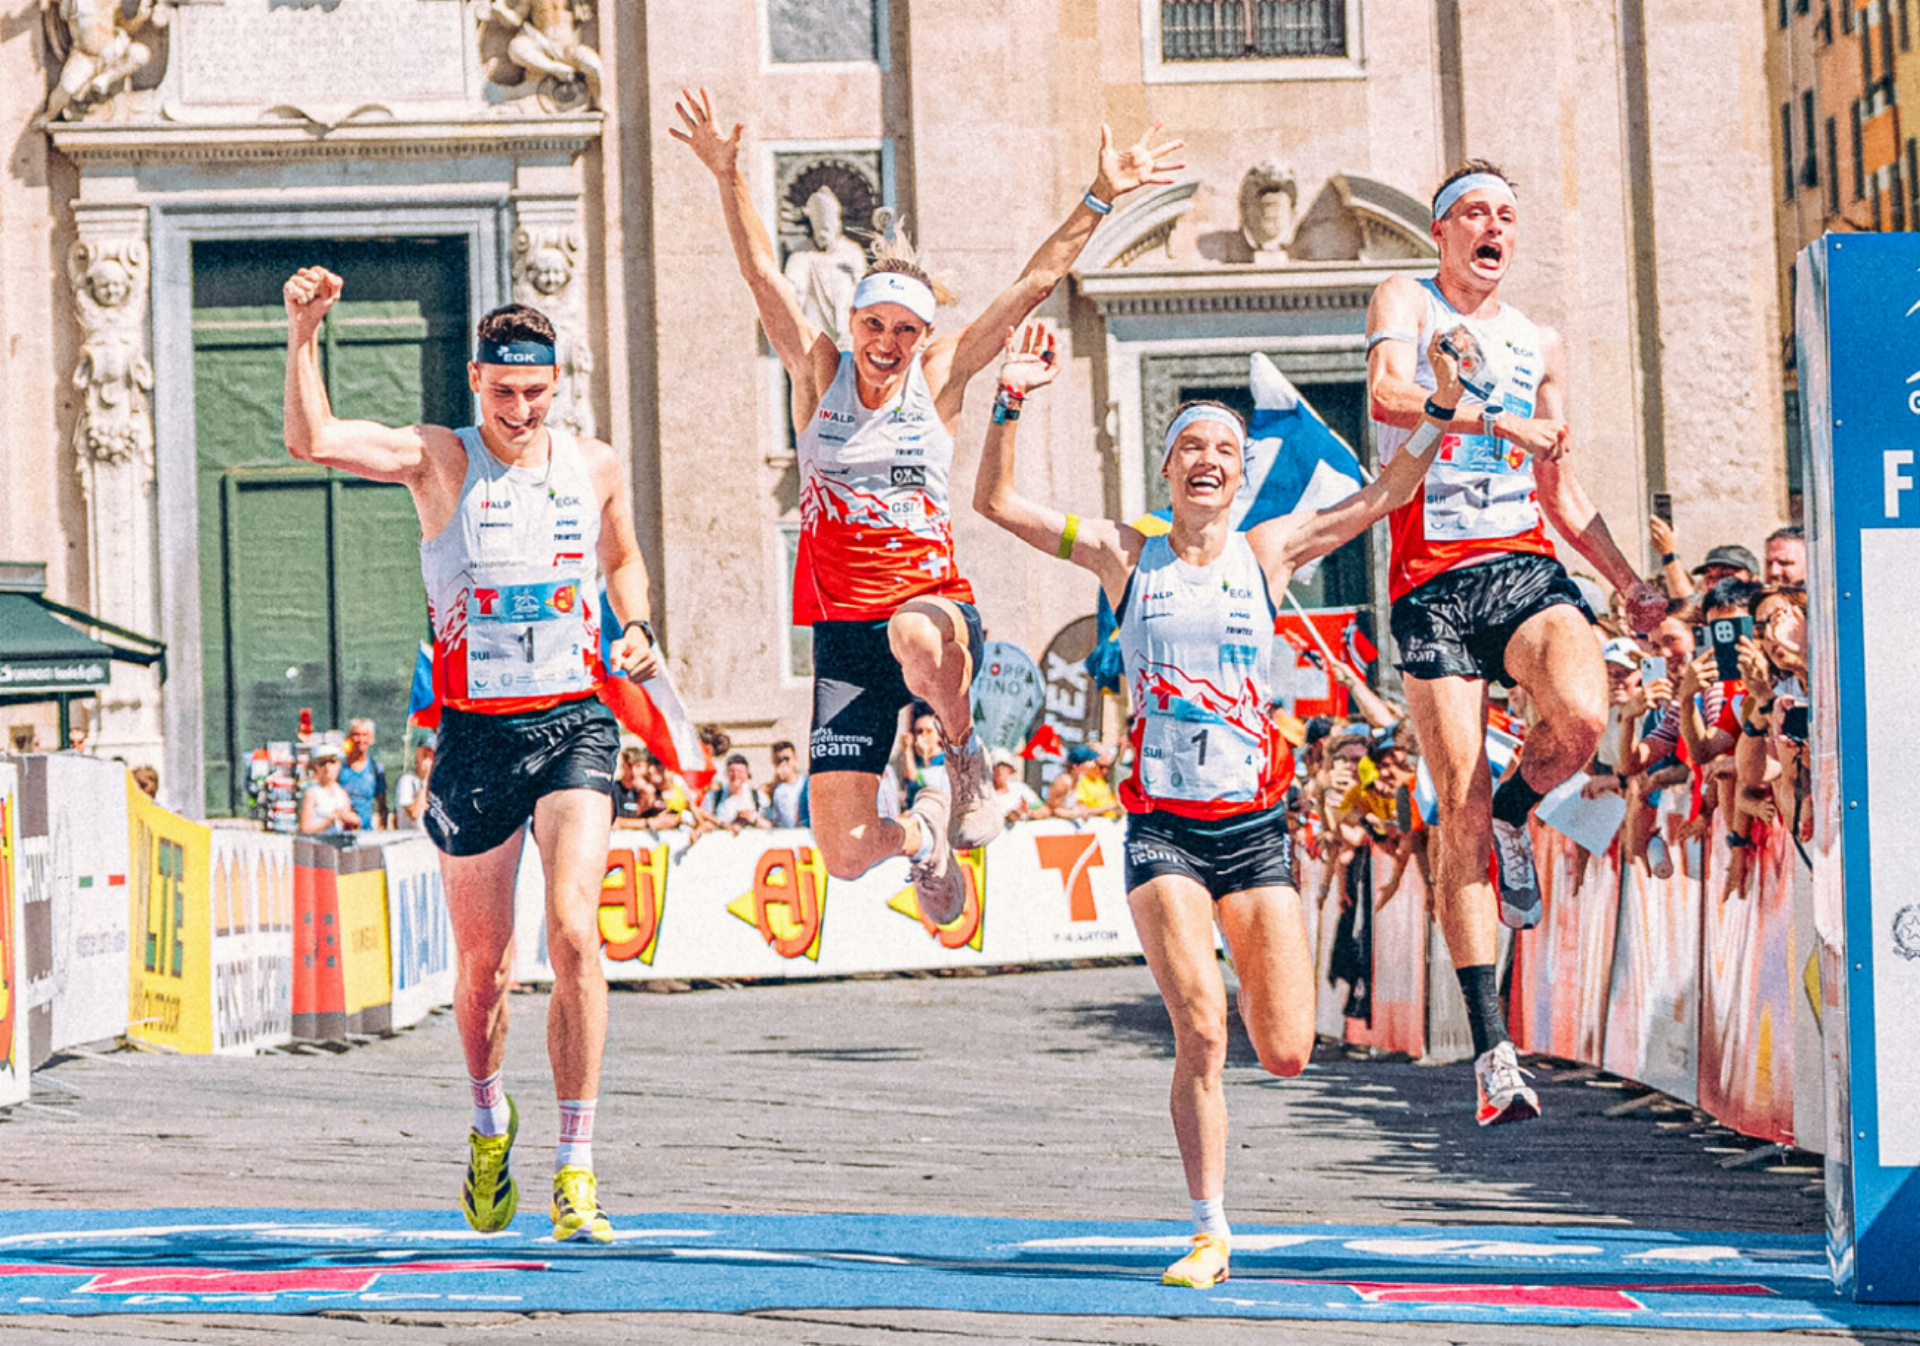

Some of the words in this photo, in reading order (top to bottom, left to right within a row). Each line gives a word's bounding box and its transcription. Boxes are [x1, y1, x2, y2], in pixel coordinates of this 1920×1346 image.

[503, 352, 536, 363] EGK
[555, 496, 580, 508] EGK
[517, 626, 534, 663] 1
[571, 643, 579, 655] 2
[470, 650, 490, 661] SUI
[1191, 728, 1209, 767] 1
[1143, 746, 1162, 759] SUI
[1245, 754, 1253, 766] 4
